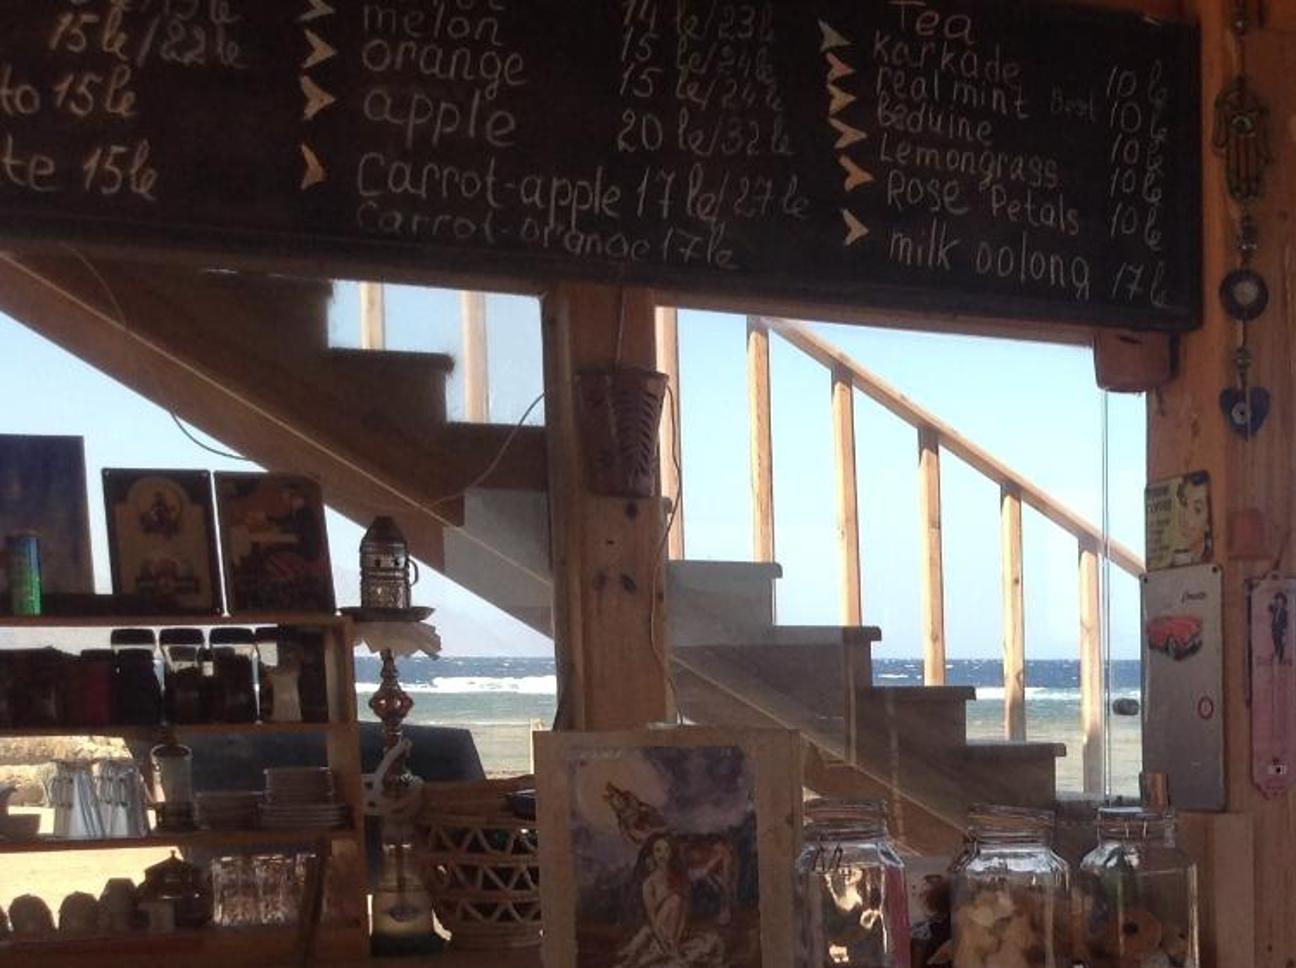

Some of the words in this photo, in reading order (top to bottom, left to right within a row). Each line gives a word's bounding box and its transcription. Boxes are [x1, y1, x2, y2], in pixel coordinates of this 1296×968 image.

[362, 3, 503, 46] melon
[888, 0, 973, 46] Tea
[361, 39, 527, 101] orange
[363, 88, 518, 150] apple
[617, 107, 664, 153] 20
[888, 169, 970, 216] Rose
[888, 217, 961, 271] milk
